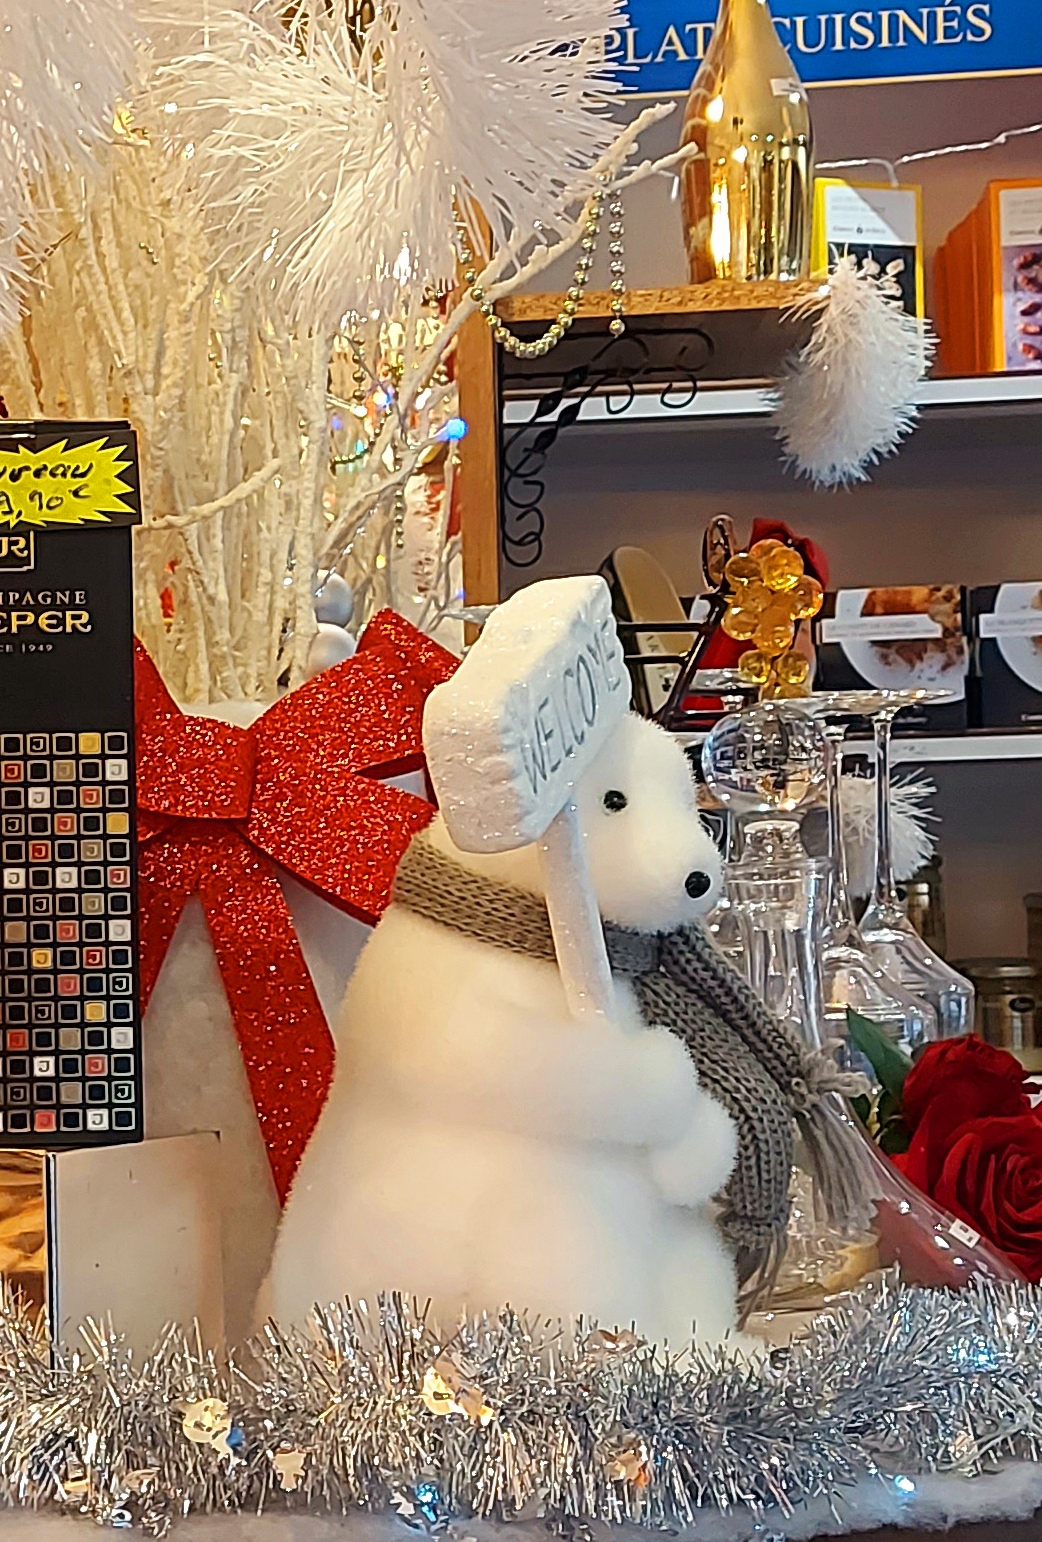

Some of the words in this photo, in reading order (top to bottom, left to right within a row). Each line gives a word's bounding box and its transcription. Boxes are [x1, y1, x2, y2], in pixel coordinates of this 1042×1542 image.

[594, 21, 720, 66] PLAT
[21, 643, 54, 654] 1949
[520, 619, 621, 795] WELCOME
